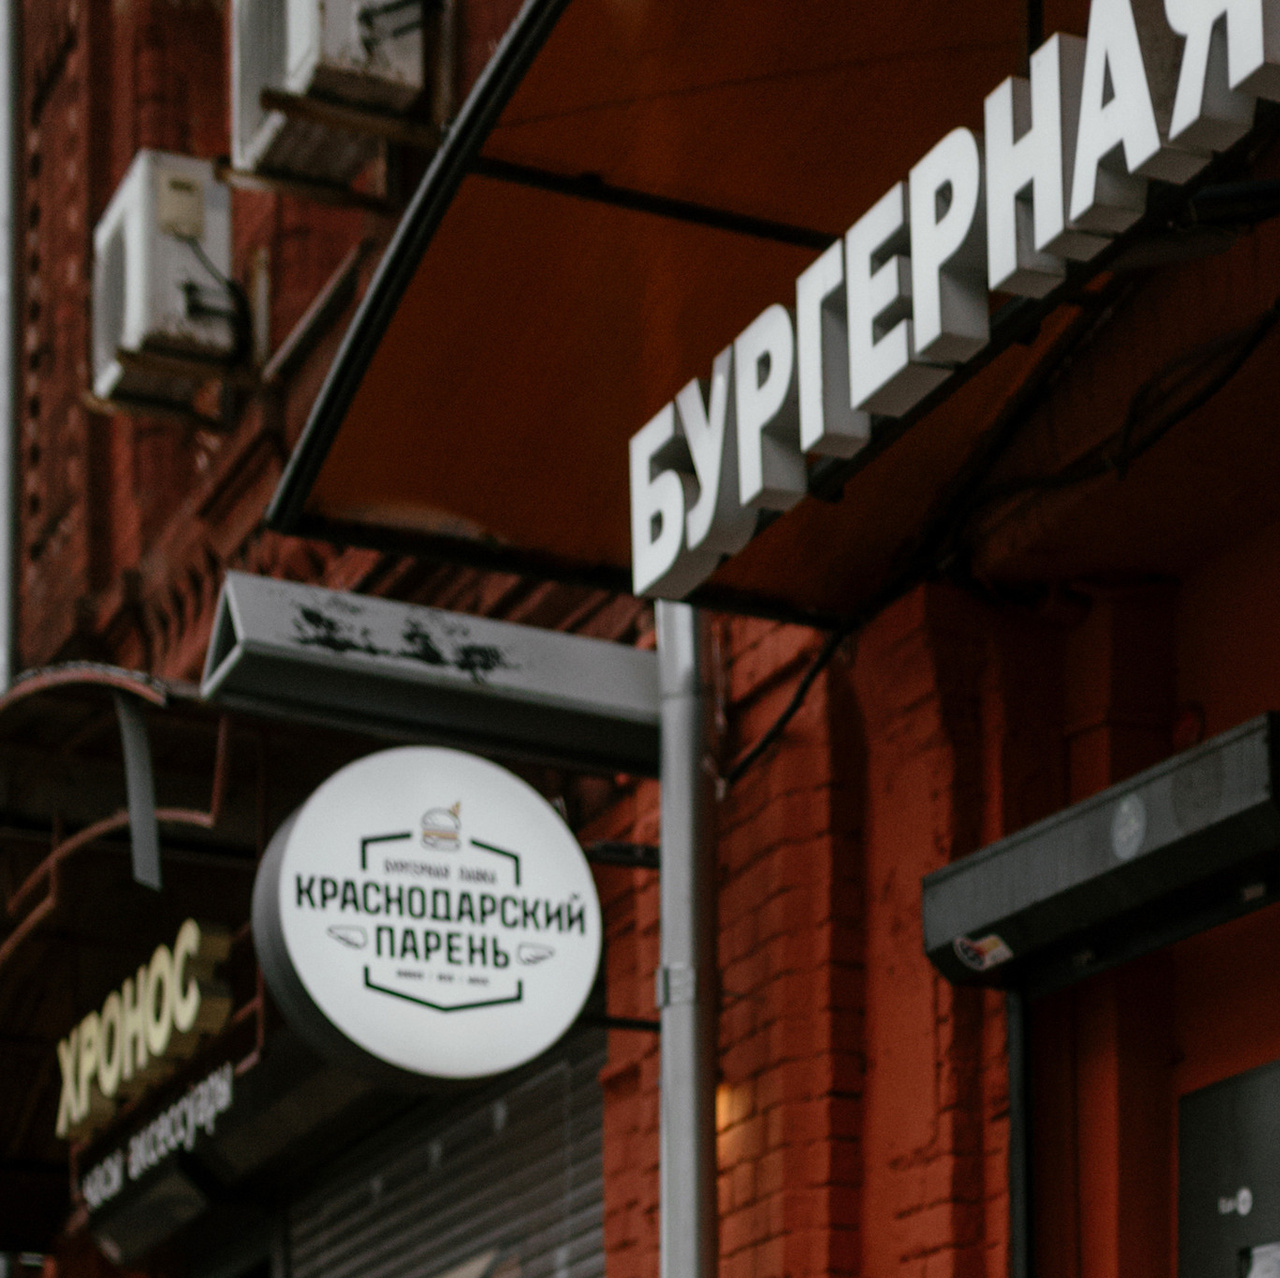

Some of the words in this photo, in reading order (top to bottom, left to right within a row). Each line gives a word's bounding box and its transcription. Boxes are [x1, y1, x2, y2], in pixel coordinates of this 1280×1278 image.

[629, 0, 1264, 598] БУРГЕРНАЯ
[294, 872, 588, 936] КРАСНОДАРСКИЙ
[375, 925, 512, 970] ПАРЕНЬ
[56, 918, 202, 1138] ХРОНОС
